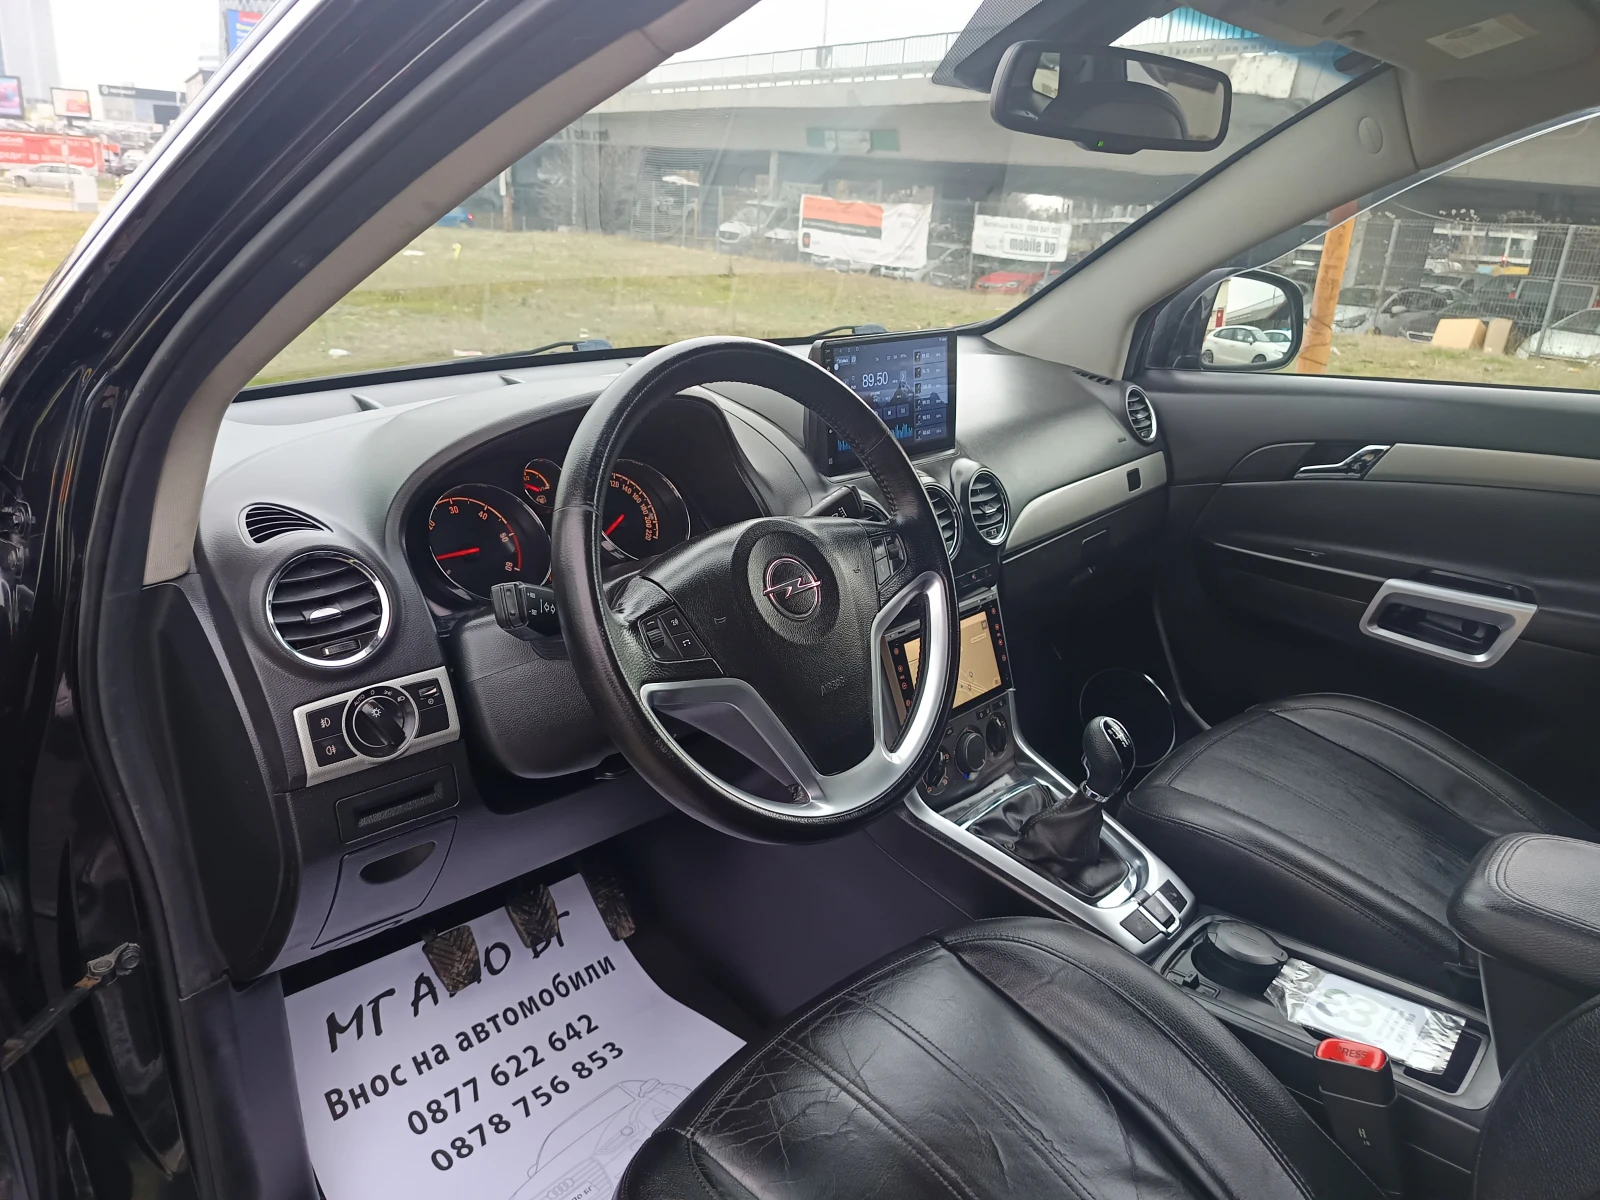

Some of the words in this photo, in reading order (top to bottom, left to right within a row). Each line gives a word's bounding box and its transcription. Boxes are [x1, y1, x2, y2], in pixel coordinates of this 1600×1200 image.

[1009, 236, 1042, 253] mobile
[1043, 238, 1056, 255] bg
[862, 371, 889, 388] 89.50
[609, 480, 620, 488] 120
[622, 484, 633, 495] 140
[448, 505, 459, 515] 30
[478, 510, 488, 520] 40
[644, 516, 653, 528] 200
[645, 528, 653, 541] 220
[504, 561, 514, 572] 60
[354, 694, 365, 706] AUTO
[326, 987, 396, 1053] МГ
[411, 942, 511, 1018] АО
[324, 1064, 408, 1121] Внос
[411, 1043, 451, 1076] на
[454, 955, 616, 1052] автомобили
[1335, 1045, 1368, 1059] PRESS
[407, 1076, 481, 1135] 0877
[490, 1044, 546, 1087] 622
[547, 1013, 600, 1053] 642
[430, 1112, 512, 1171] 0878
[511, 1075, 571, 1118] 756
[571, 1041, 624, 1080] 853
